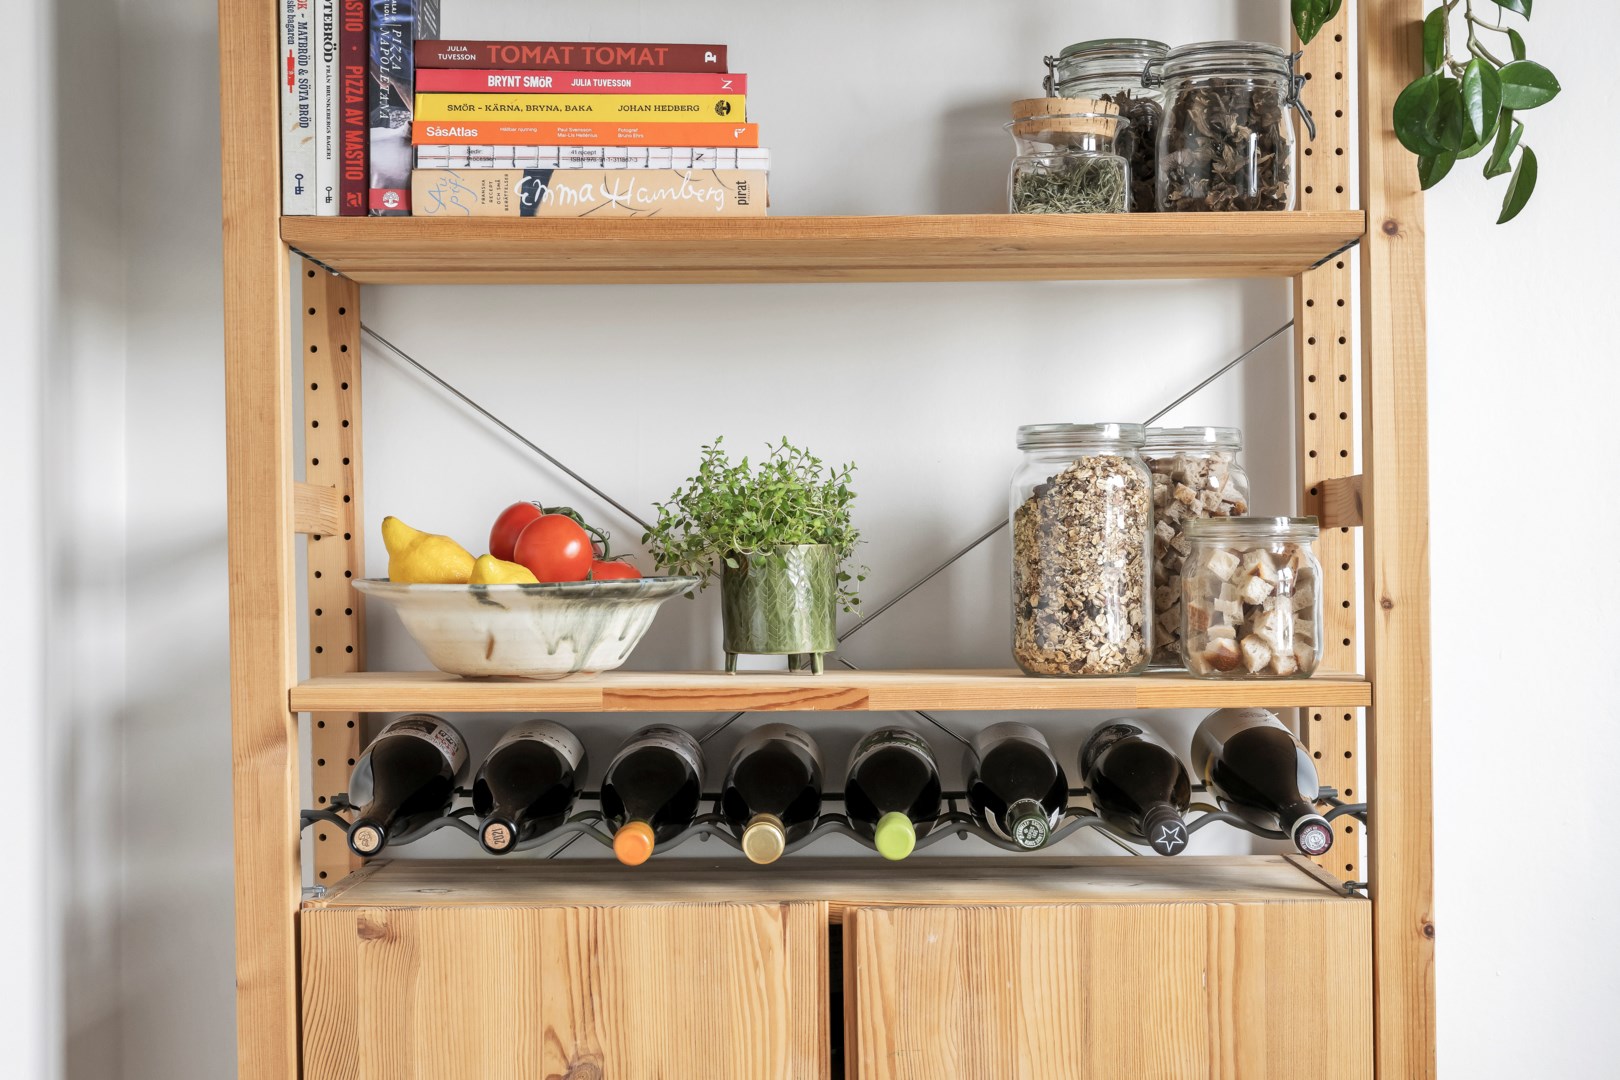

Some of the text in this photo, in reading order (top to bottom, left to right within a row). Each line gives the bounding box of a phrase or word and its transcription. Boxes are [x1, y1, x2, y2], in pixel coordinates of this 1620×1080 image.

[285, 14, 296, 45] bagaren
[323, 0, 337, 63] TEBRÖD
[298, 22, 311, 66] MATBRÖD
[390, 29, 402, 70] PIZZA
[486, 45, 669, 66] TOMAT TOMAT
[438, 53, 477, 61] TUVESSON
[380, 28, 390, 119] NAPOLETANA
[488, 75, 521, 88] BRYNT
[571, 79, 632, 88] JULIA TUVESSON
[298, 78, 311, 102] SÖTA
[345, 0, 364, 180] STIO PIZZA AV MASTIO
[299, 104, 311, 128] BRÖD
[447, 103, 476, 112] SMÖR
[484, 103, 523, 113] KÄRNA,
[526, 105, 563, 113] BRYNA,
[565, 104, 593, 112] BAKA
[618, 104, 651, 112] JOHAN
[426, 126, 478, 137] SåsAtlas
[514, 175, 596, 206] Emma
[600, 170, 725, 211] Hamberg
[734, 180, 750, 206] pirat
[491, 828, 506, 845] 2021
